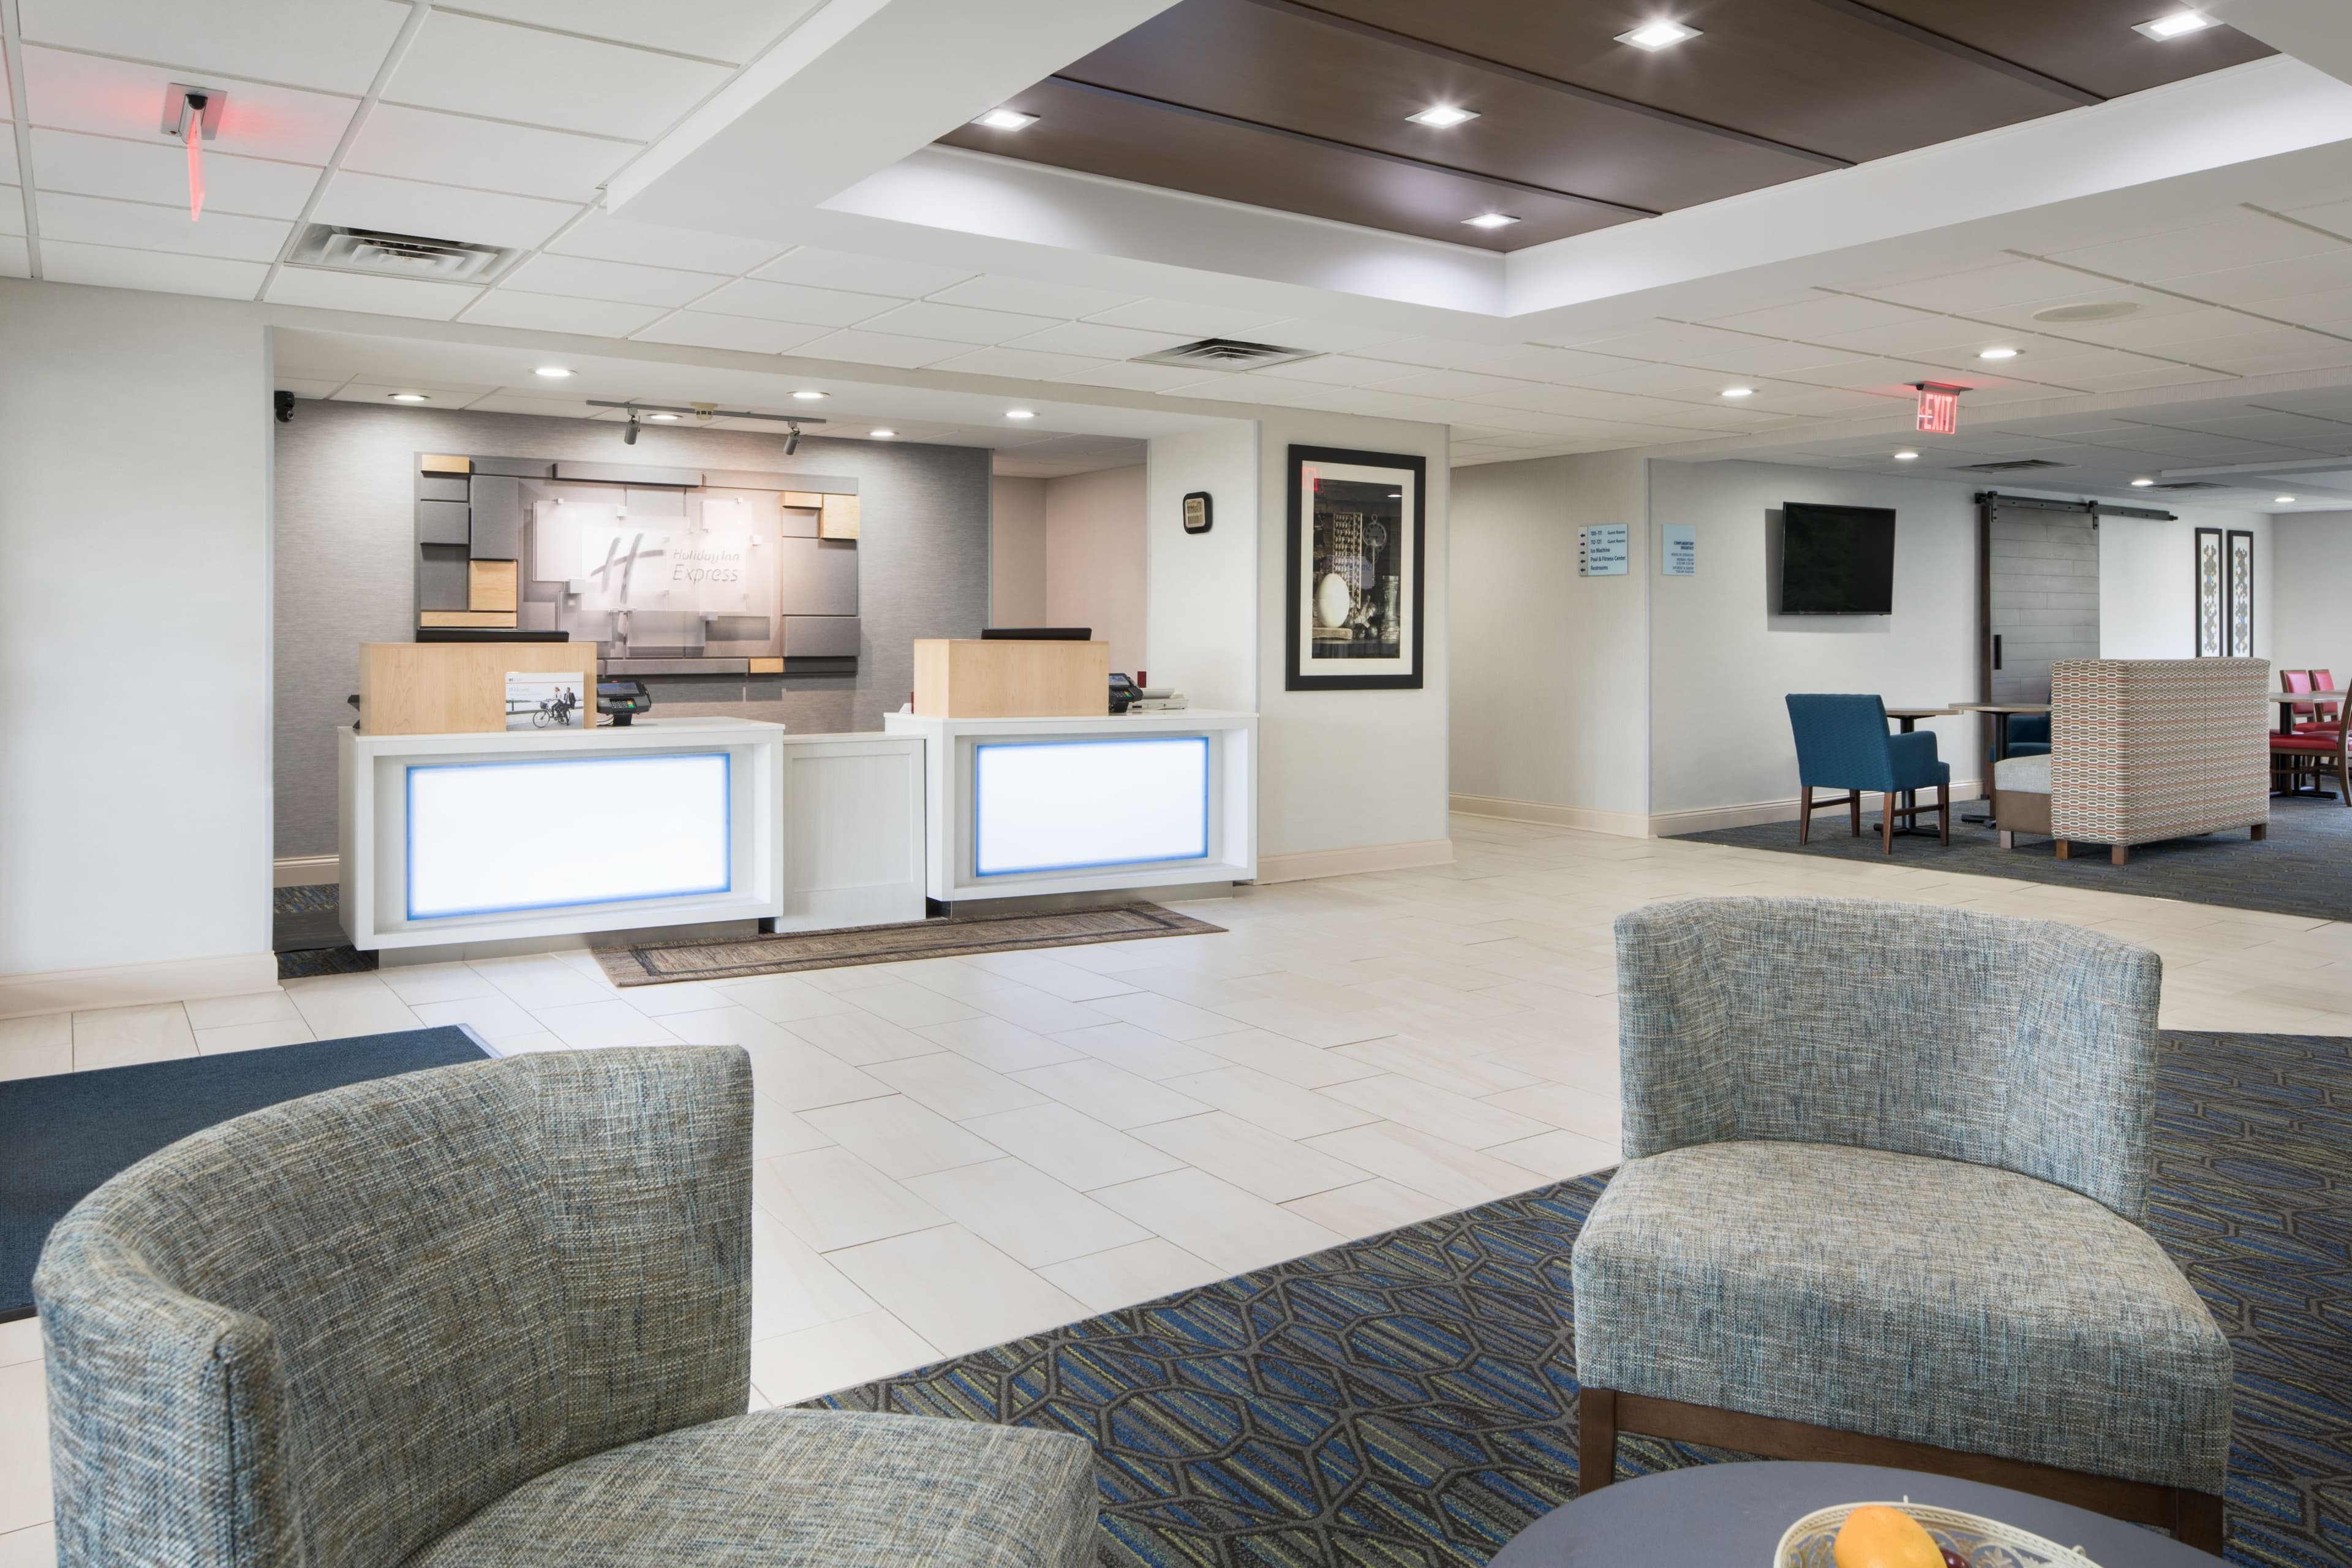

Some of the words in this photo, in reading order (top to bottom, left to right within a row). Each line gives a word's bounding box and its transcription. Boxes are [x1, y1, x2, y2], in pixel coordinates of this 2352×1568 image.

[1924, 393, 1953, 431] EXIT
[673, 548, 720, 564] Holiday
[721, 549, 740, 561] Inn
[673, 564, 739, 586] Express
